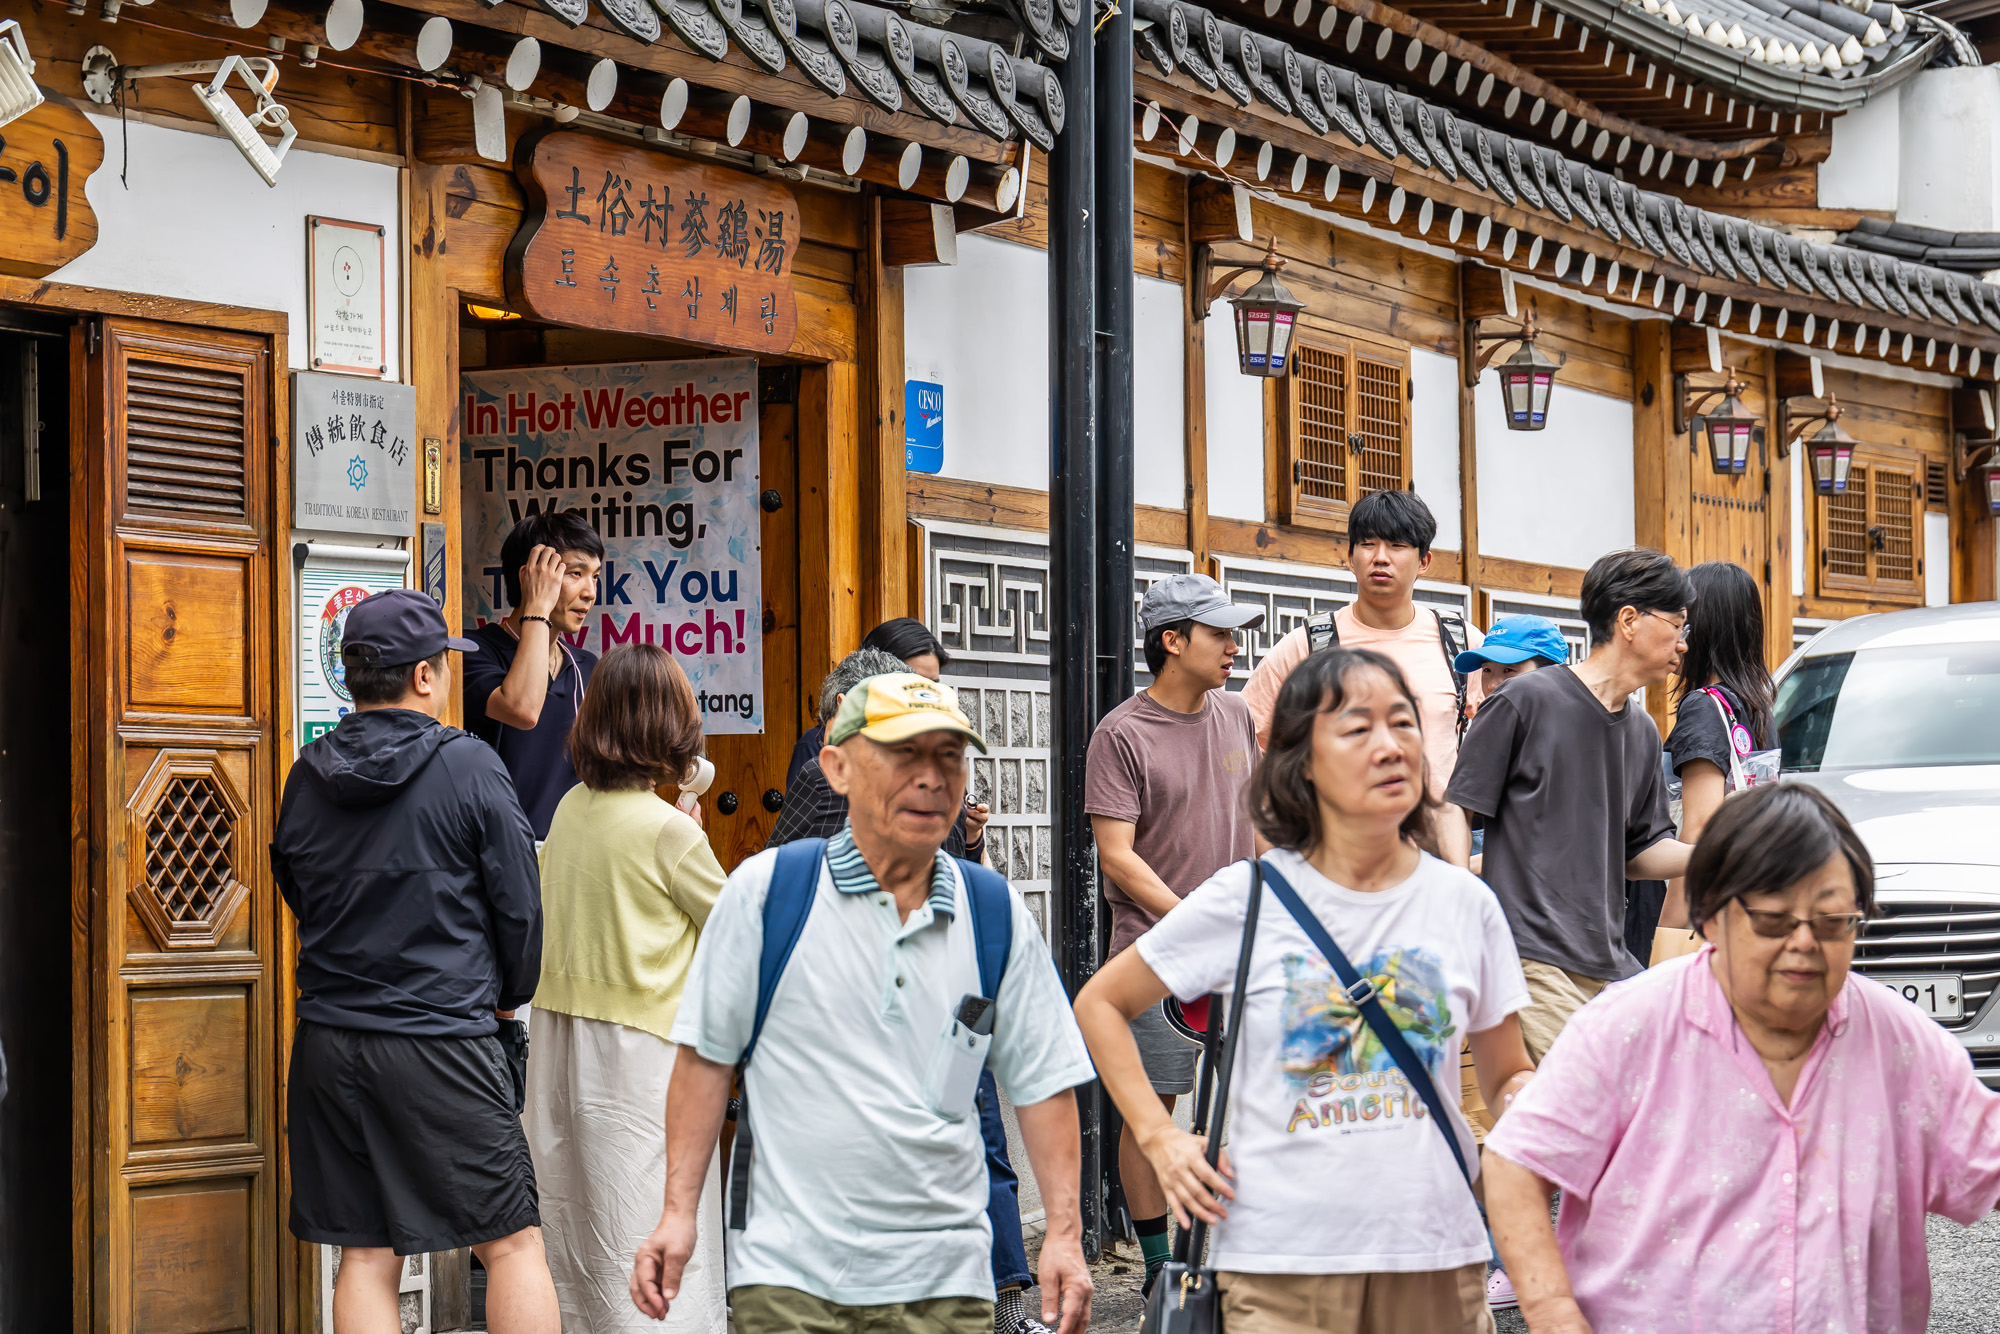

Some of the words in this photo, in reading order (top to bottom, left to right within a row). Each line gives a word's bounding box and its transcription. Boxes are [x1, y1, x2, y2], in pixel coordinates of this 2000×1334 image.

[466, 394, 499, 435] In
[506, 392, 576, 434] Hot
[583, 382, 750, 430] Weather
[918, 388, 942, 412] CESCO
[473, 442, 651, 493] Thanks
[663, 439, 743, 485] For
[304, 502, 343, 518] TRADITIONAL
[346, 505, 370, 519] KOREAN
[371, 507, 409, 523] RESTAURANT
[508, 490, 708, 549] Witing,
[643, 559, 738, 605] You
[601, 608, 746, 656] Much!
[695, 689, 754, 720] tang
[1886, 983, 1937, 1013] 91
[1307, 1066, 1412, 1098] Sout
[1286, 1085, 1433, 1133] Americ
